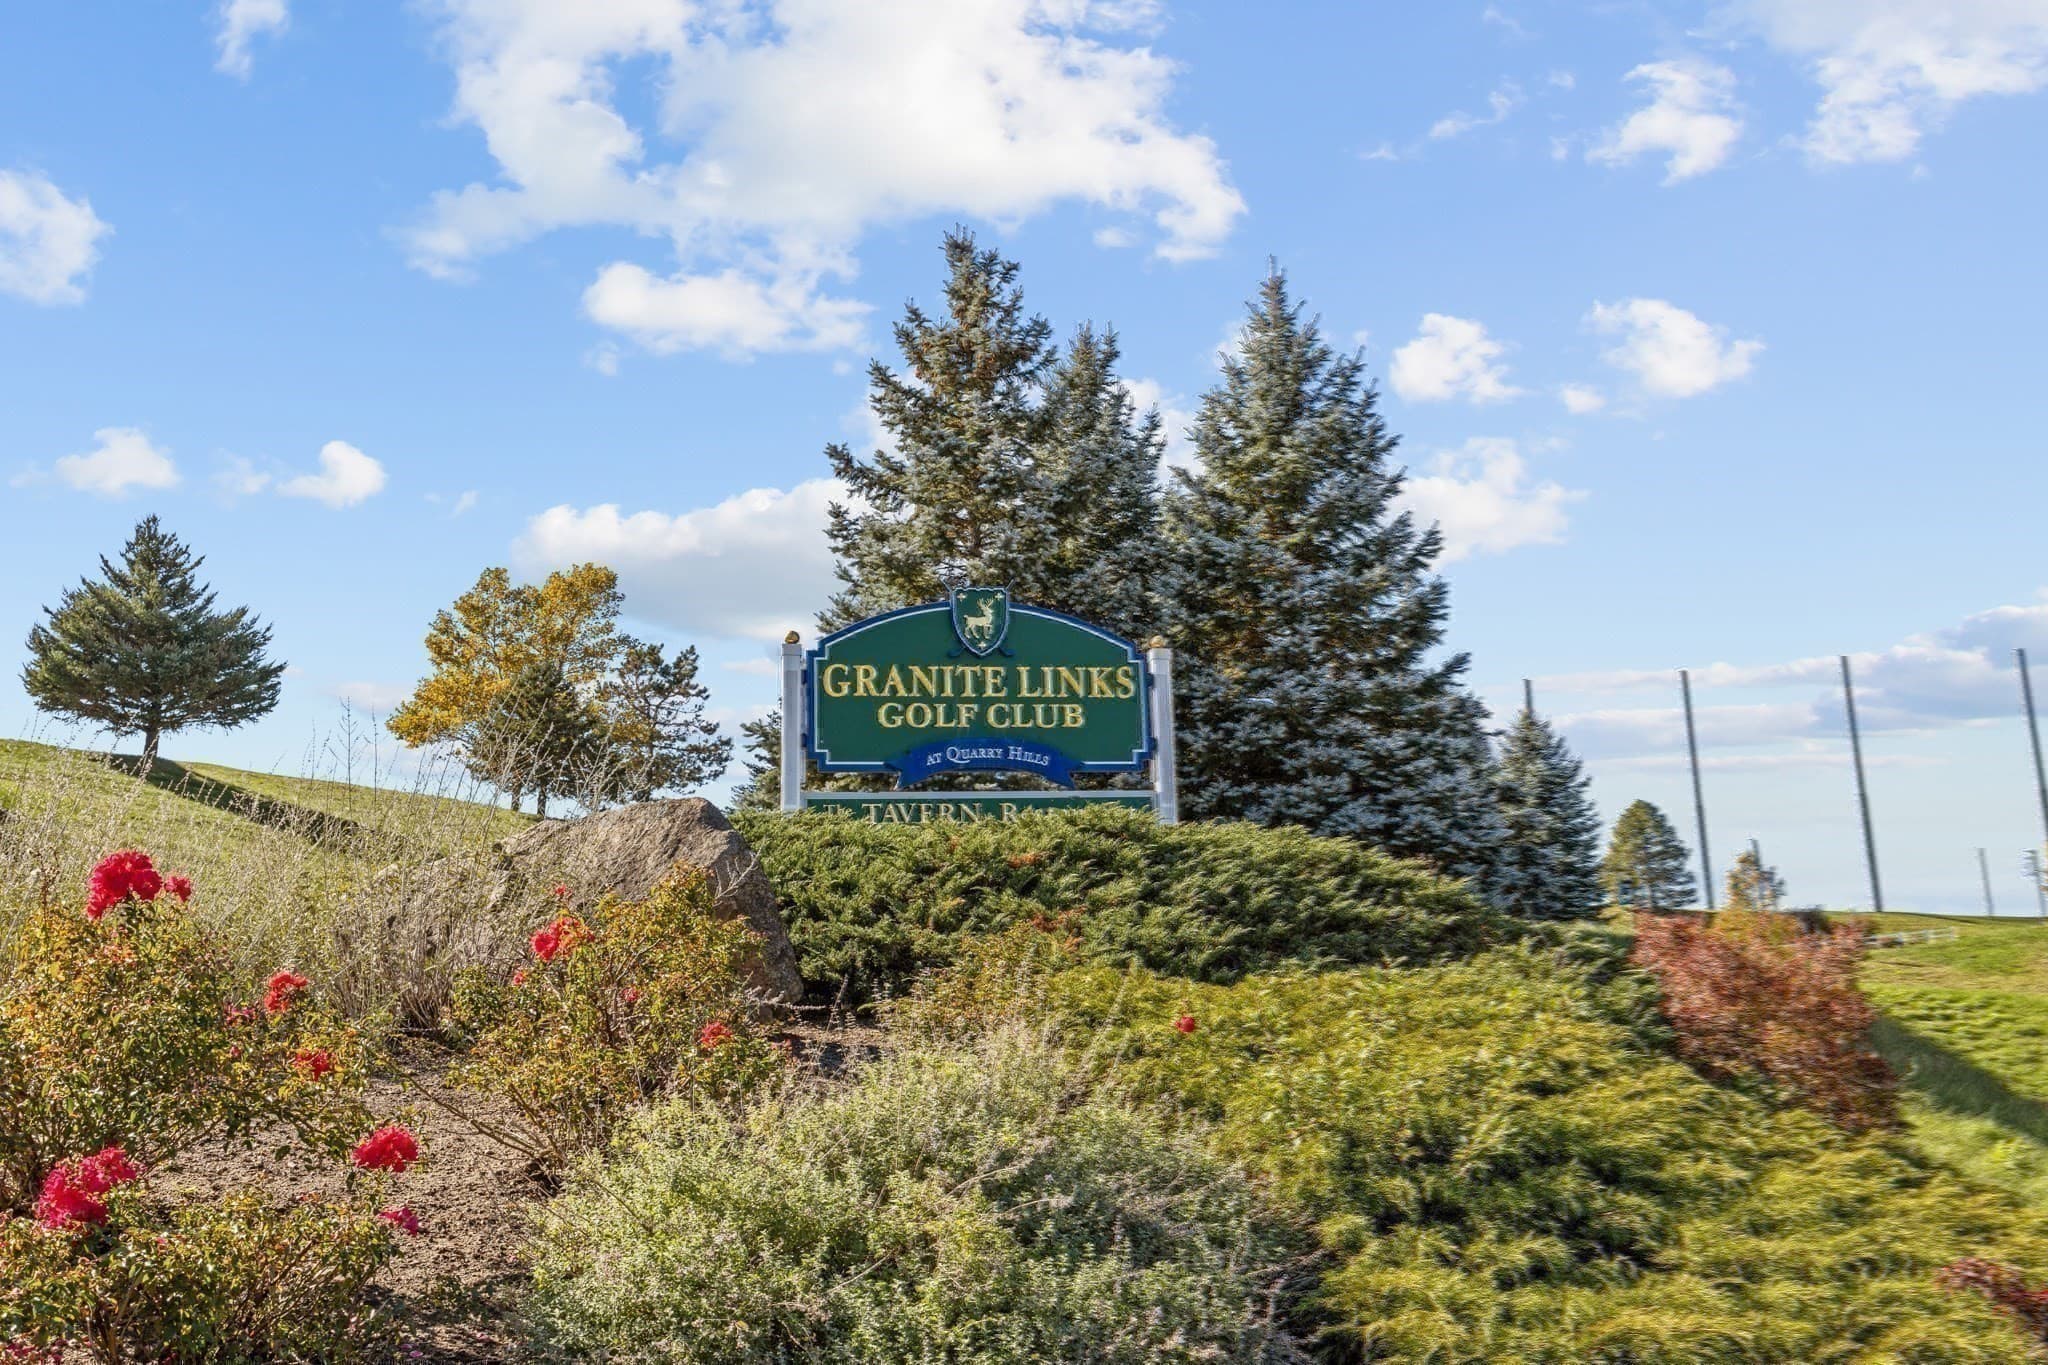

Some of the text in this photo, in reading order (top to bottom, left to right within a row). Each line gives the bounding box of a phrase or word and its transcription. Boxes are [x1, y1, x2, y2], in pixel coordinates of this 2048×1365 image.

[823, 664, 1135, 699] GRANITE LINKS
[877, 703, 1085, 729] GOLF CLUB
[926, 746, 1049, 766] AT QUARRY HILLS
[861, 802, 982, 825] TAVERN
